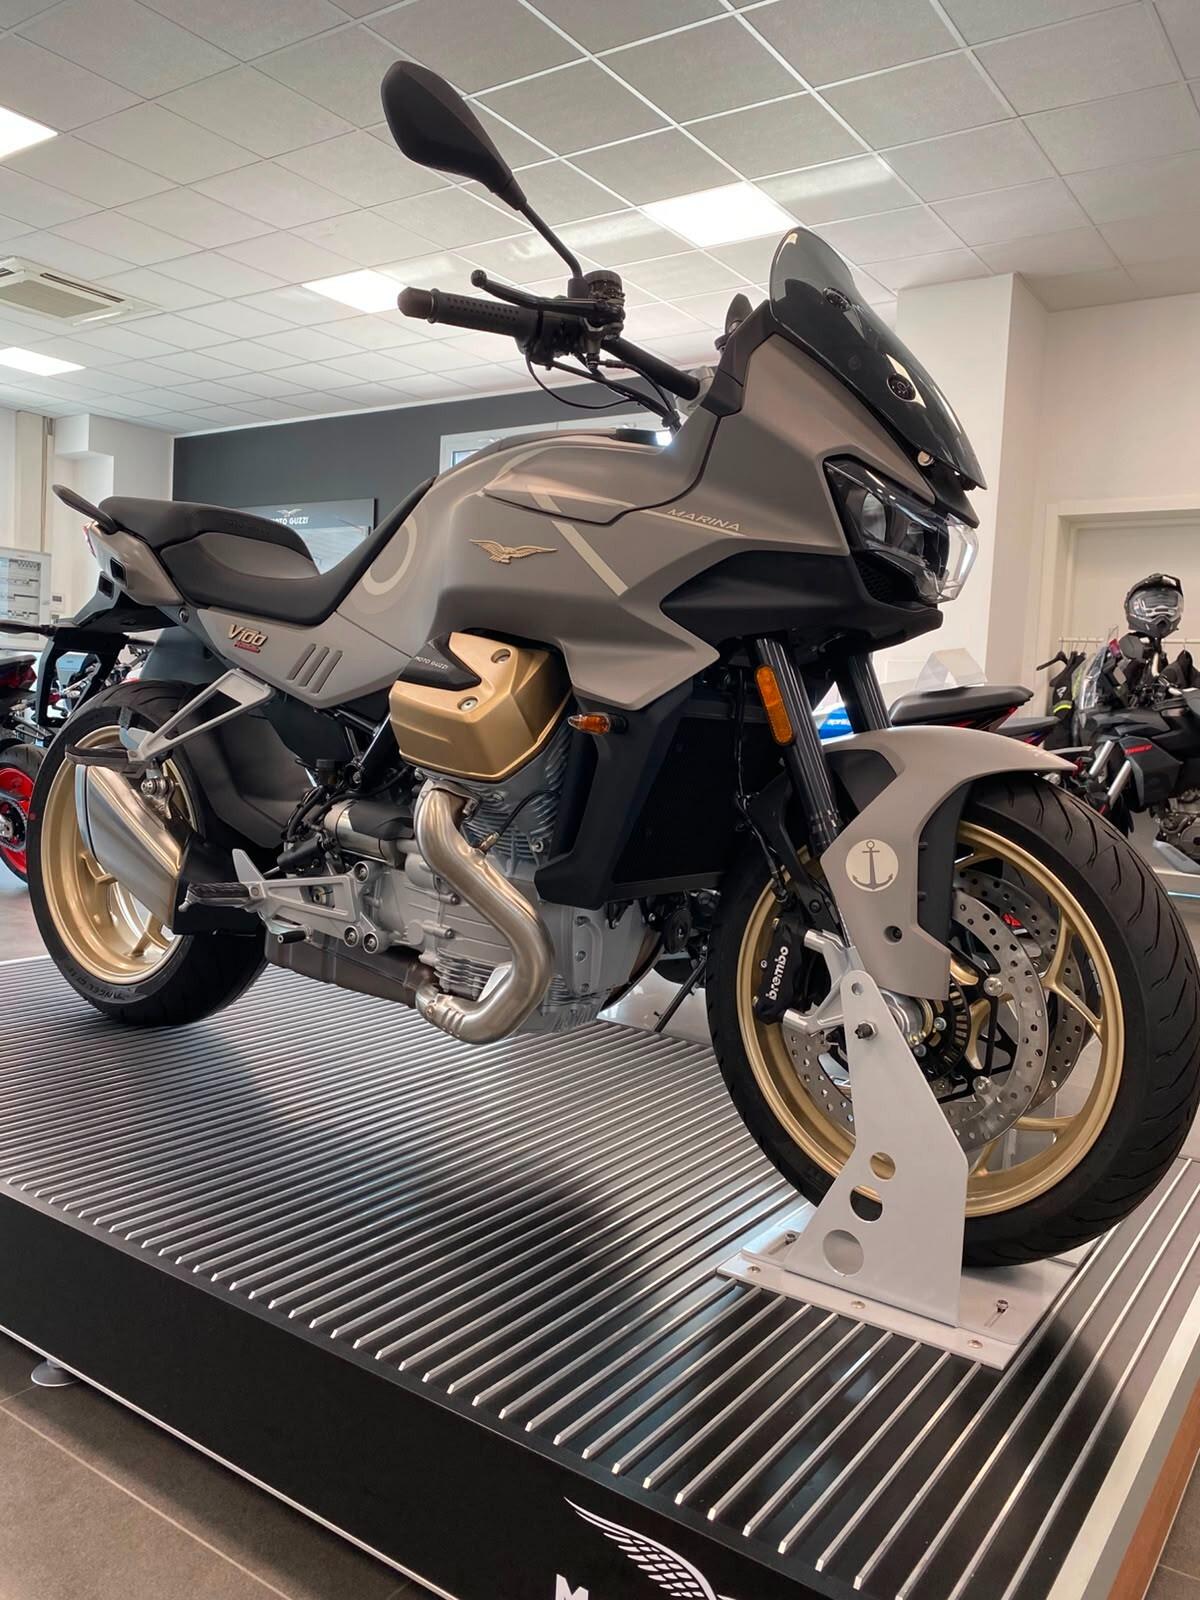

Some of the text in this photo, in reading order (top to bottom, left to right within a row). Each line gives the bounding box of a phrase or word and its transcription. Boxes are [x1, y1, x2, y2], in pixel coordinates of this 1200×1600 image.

[289, 516, 309, 525] GUZZI
[667, 508, 740, 531] MARINA
[765, 946, 789, 1000] brembo
